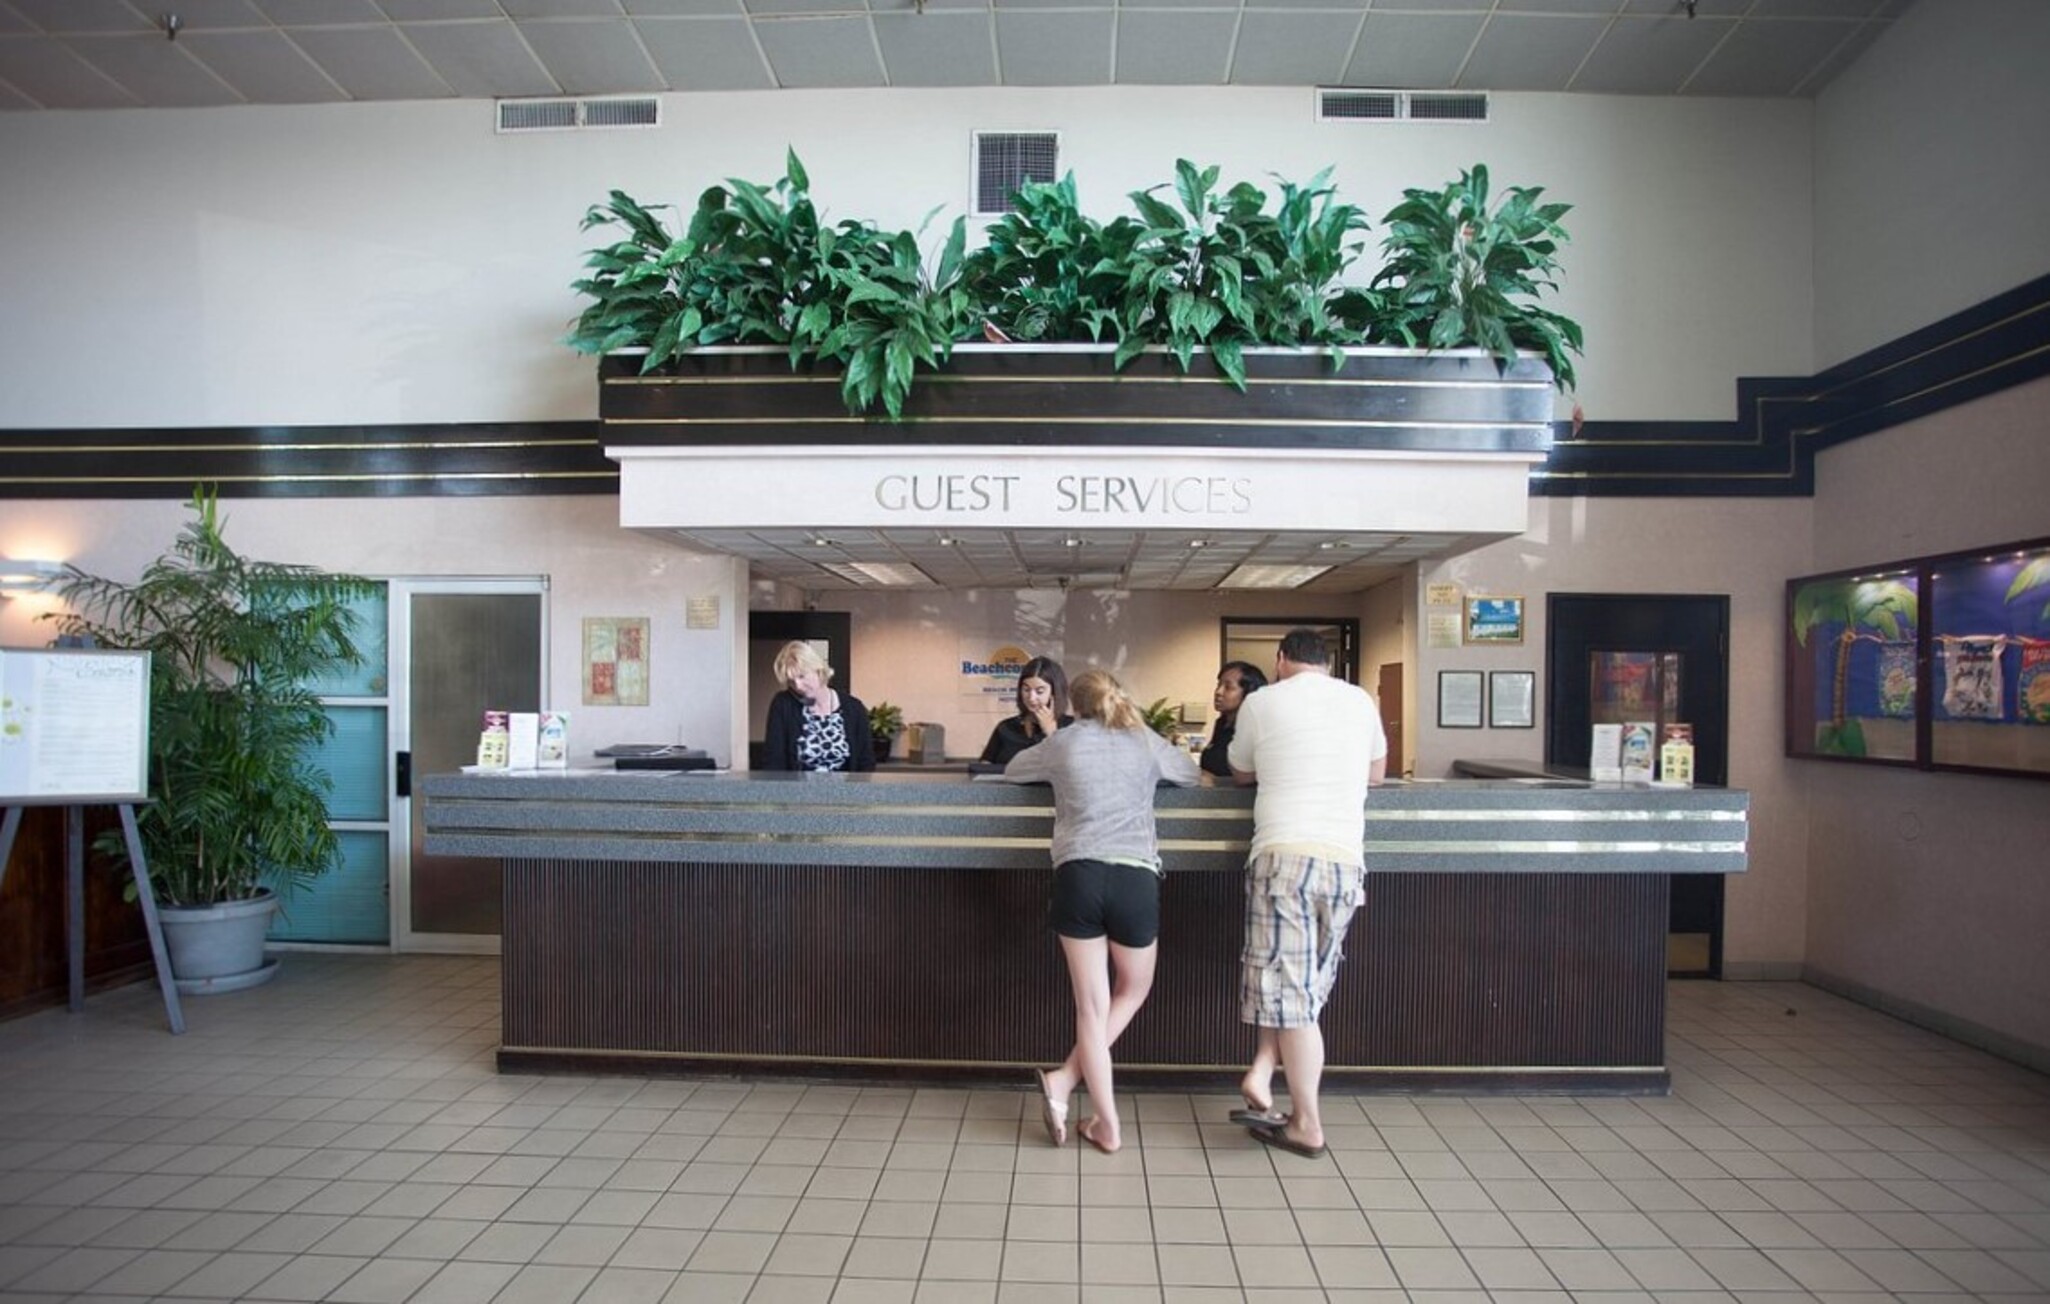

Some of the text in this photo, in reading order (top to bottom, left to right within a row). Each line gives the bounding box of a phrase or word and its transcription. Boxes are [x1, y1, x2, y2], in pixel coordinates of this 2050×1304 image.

[875, 474, 1252, 514] GUEST SERVICES
[963, 661, 1022, 674] Beachco
